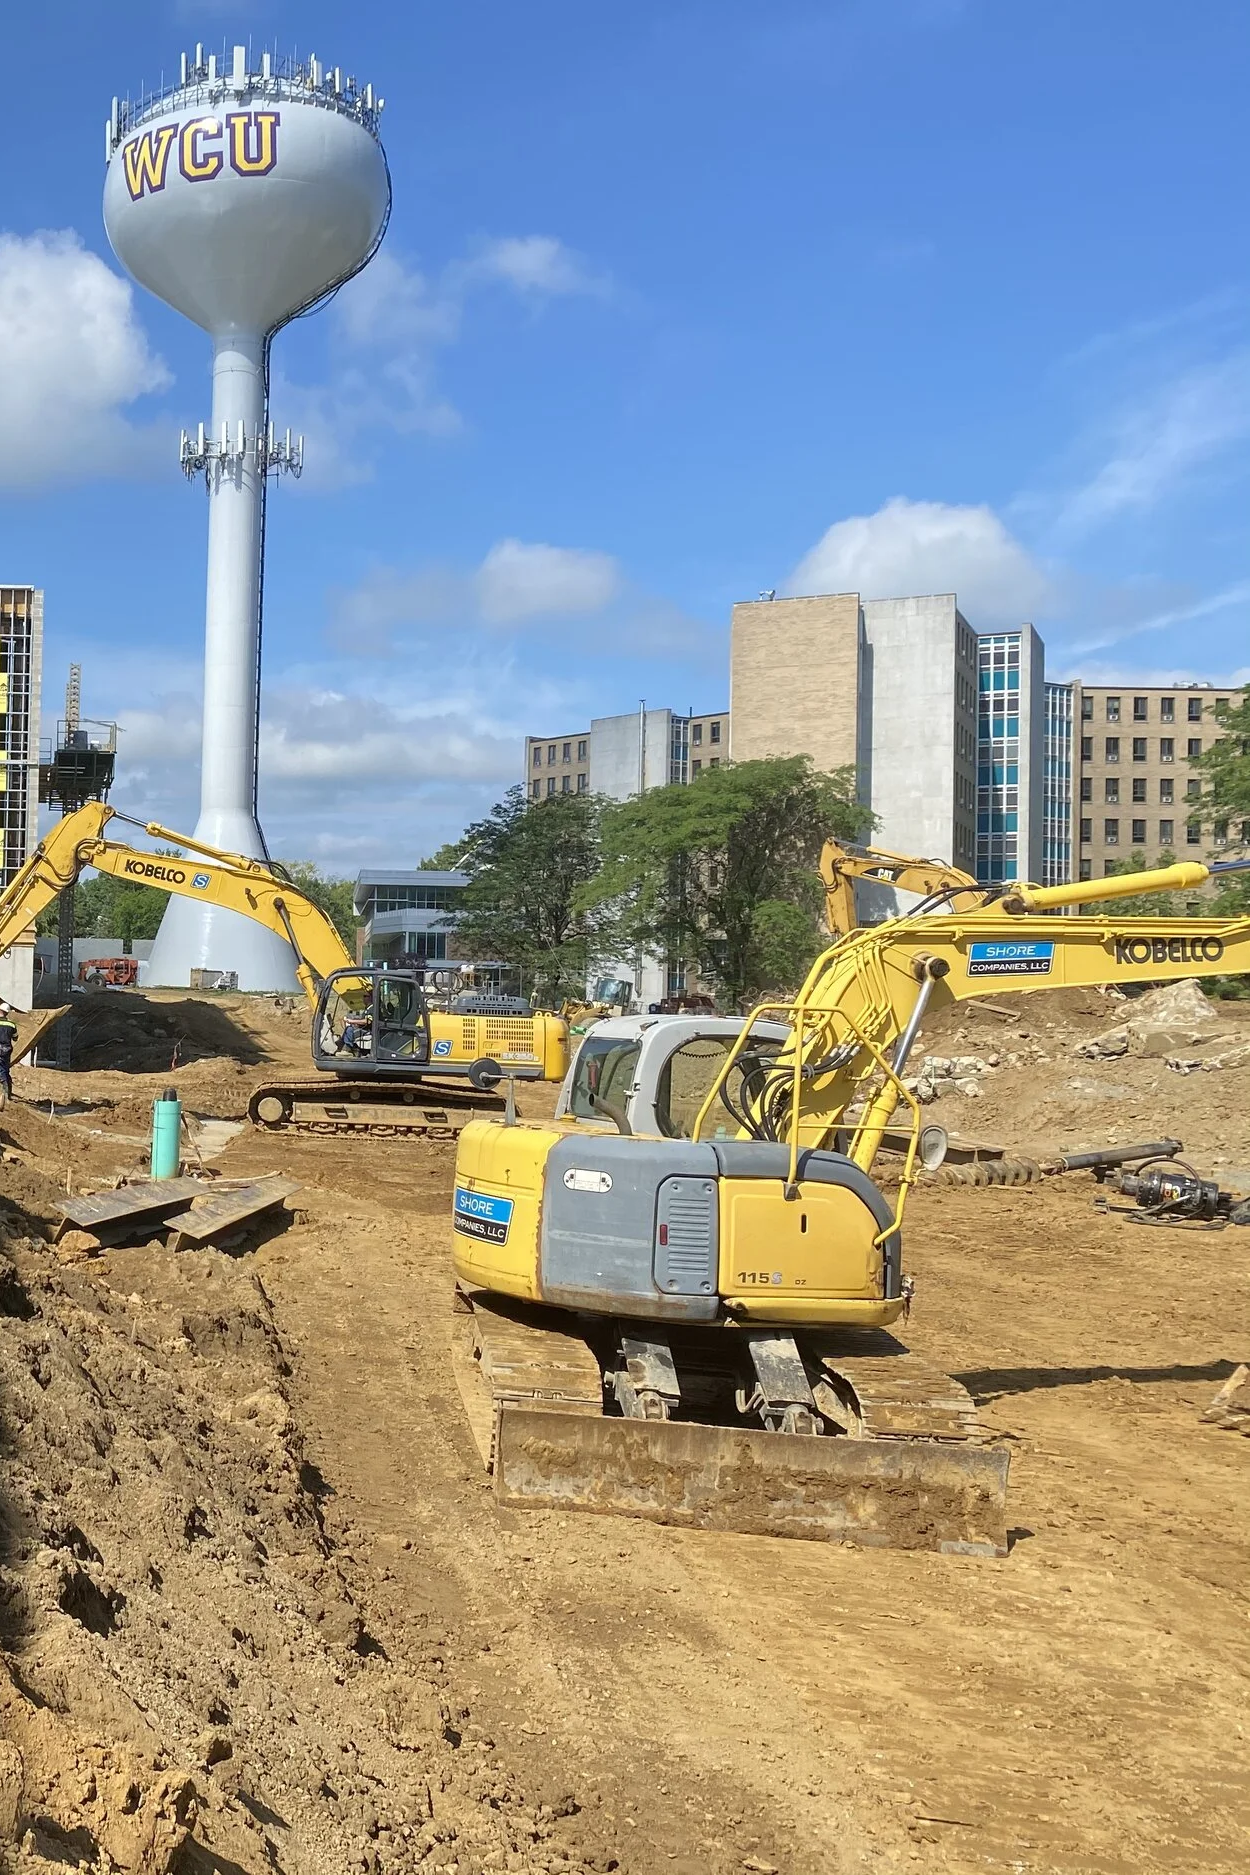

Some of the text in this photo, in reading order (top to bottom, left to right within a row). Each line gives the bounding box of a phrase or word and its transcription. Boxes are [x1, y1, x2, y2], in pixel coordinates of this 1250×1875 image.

[122, 112, 280, 201] WCU
[125, 859, 186, 884] KOBELCO
[878, 868, 894, 881] CAT
[986, 946, 1036, 956] SHORE
[1116, 936, 1224, 964] KOBELCO
[971, 962, 1048, 972] COMPANIES, LLC
[460, 1195, 494, 1216] SHORE
[488, 1227, 504, 1238] LLC
